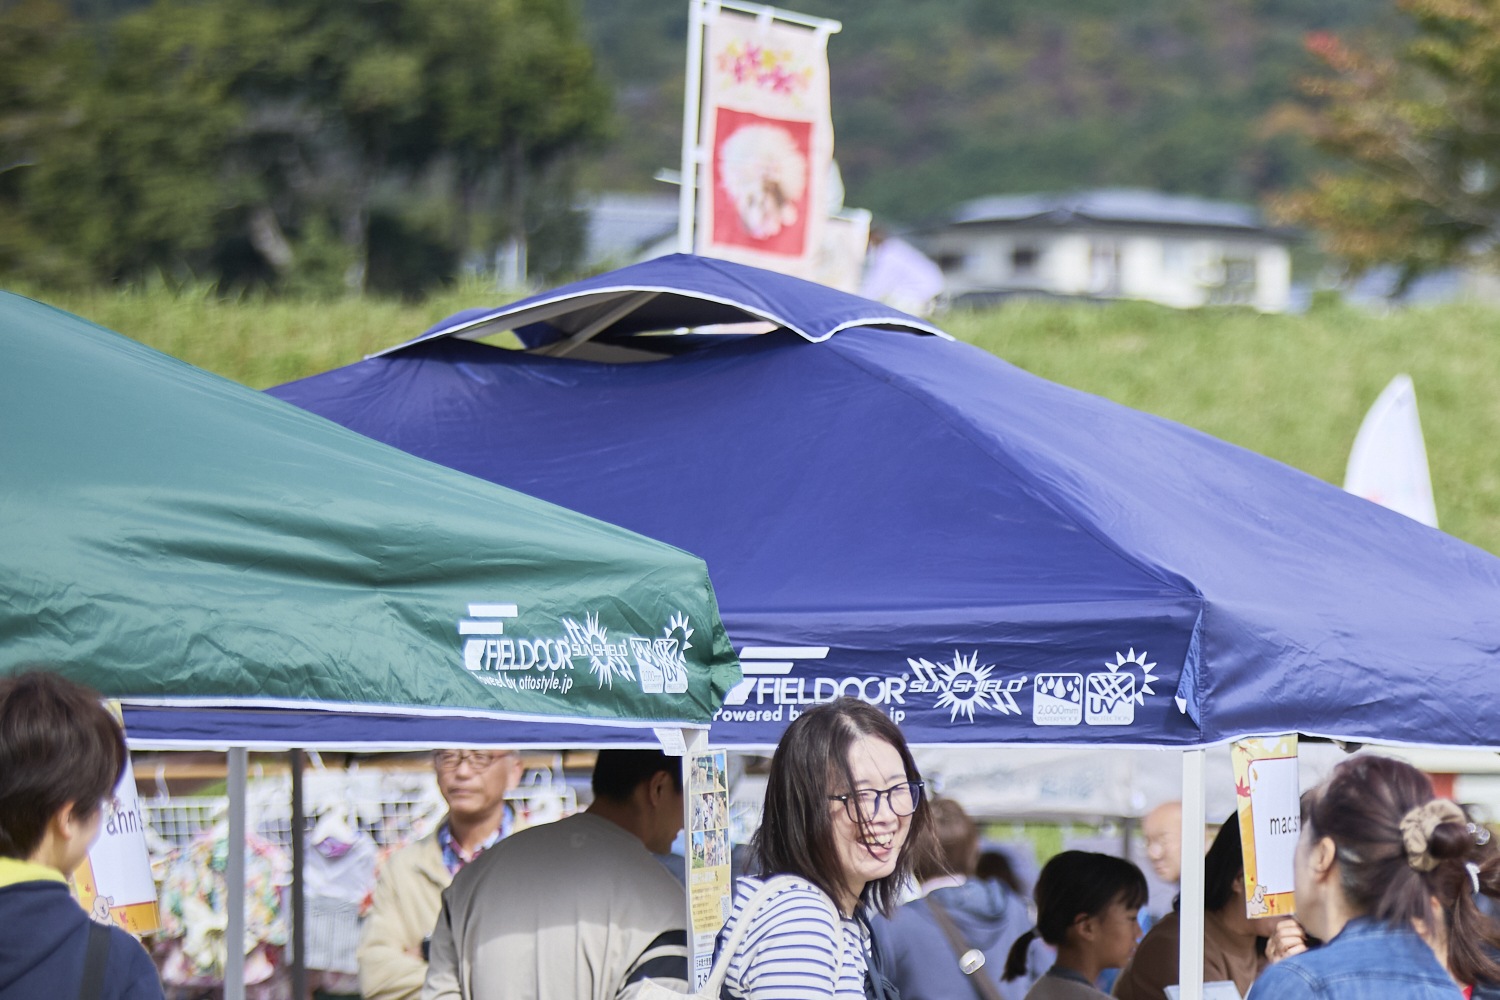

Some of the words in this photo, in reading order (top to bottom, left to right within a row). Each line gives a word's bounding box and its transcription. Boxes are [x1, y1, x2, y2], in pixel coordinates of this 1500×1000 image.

[485, 639, 574, 671] FIELDOOR
[519, 672, 574, 694] ottostyle.jp
[757, 677, 906, 705] FIELDOOR
[789, 705, 802, 722] b
[1037, 704, 1079, 716] 2,000mm
[1089, 697, 1120, 714] UV
